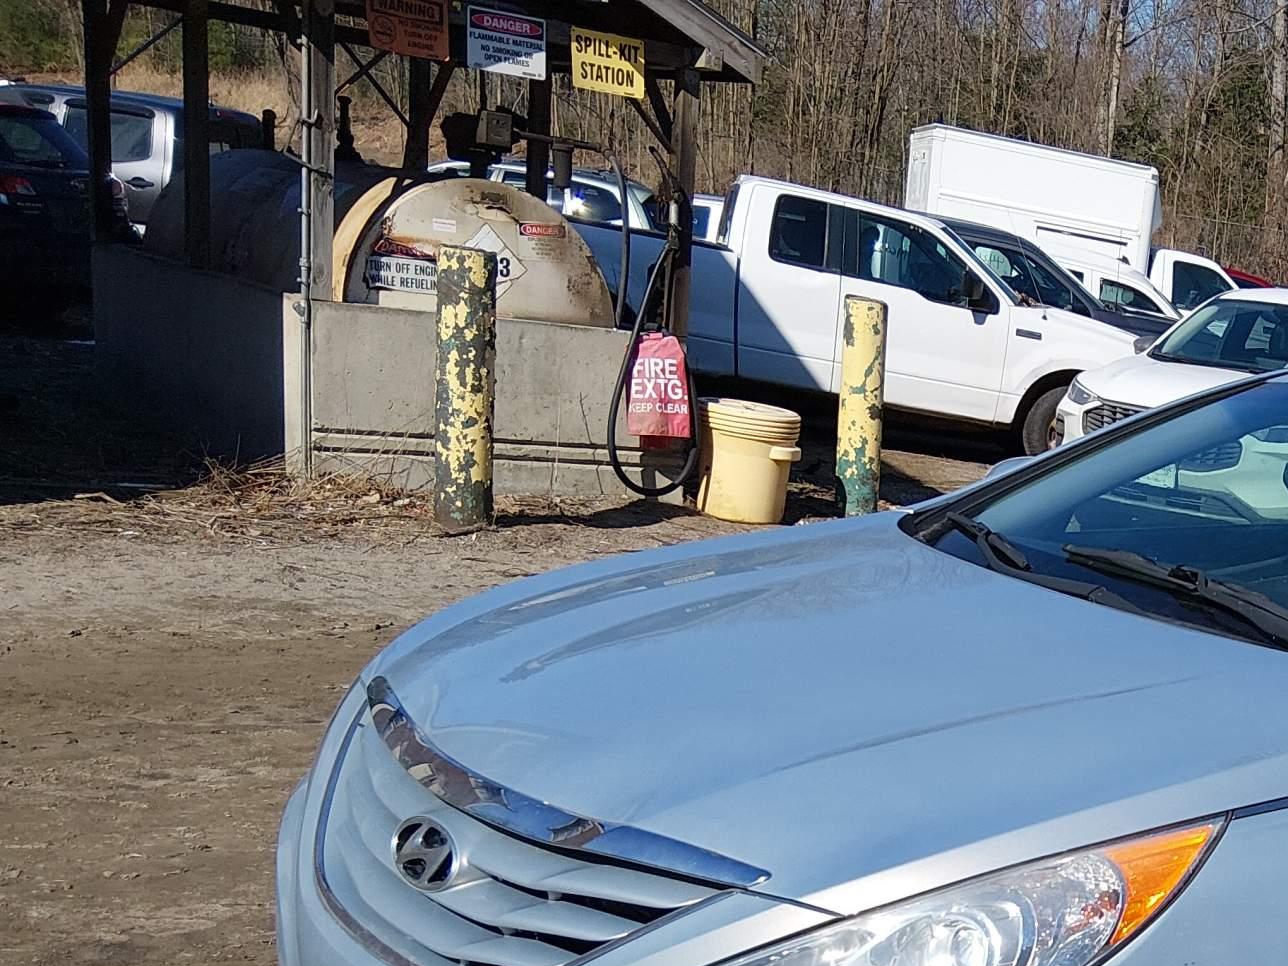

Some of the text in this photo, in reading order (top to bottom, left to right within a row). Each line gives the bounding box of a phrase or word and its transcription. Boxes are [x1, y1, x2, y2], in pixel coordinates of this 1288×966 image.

[376, 0, 436, 19] WARNING
[483, 15, 531, 33] DANGER
[469, 31, 545, 51] FLAMMABLE MATERIAL
[575, 34, 641, 64] SPILL-KIT
[480, 43, 534, 60] NO SMOKING OR
[484, 53, 530, 68] OPEN FLAMES
[580, 61, 635, 88] STATION
[526, 225, 559, 237] DANGER
[369, 259, 437, 277] TURN OFF ENGIN
[369, 273, 437, 291] WHILE REFUELIN
[632, 357, 678, 379] FIRE
[631, 378, 689, 400] EXTG.
[629, 401, 688, 414] KEEP CLEAR
